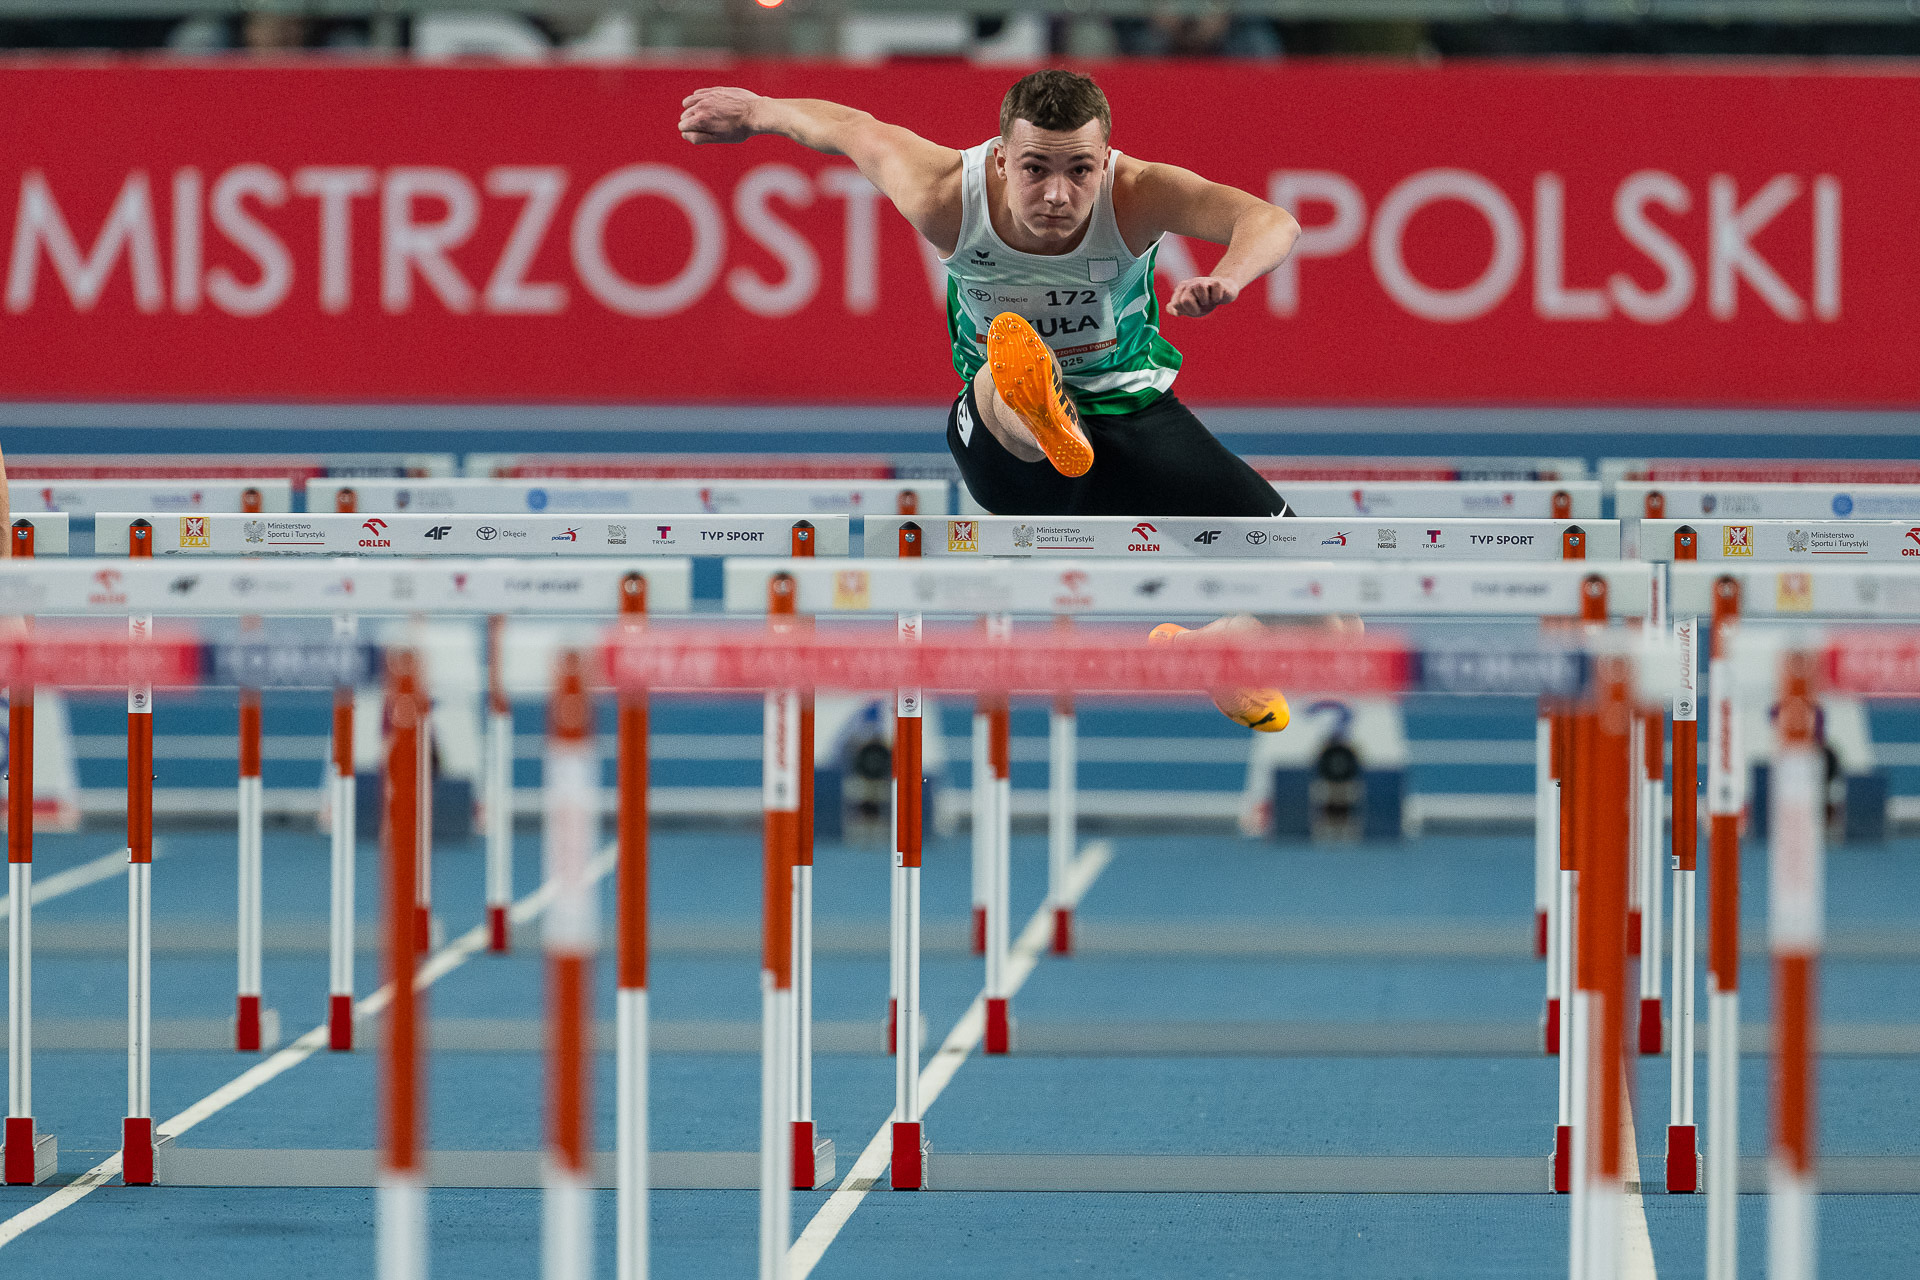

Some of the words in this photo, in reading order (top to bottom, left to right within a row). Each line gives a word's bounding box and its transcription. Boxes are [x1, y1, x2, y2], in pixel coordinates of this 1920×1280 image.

[4, 164, 1204, 318] MISTRZOST
[1265, 167, 1843, 323] POLSKI
[970, 258, 996, 267] erima
[998, 296, 1029, 304] Okęcie
[1045, 290, 1098, 306] 172
[1060, 356, 1084, 368] 025
[267, 522, 311, 530] Ministerstwo
[267, 530, 290, 539] Sportu
[296, 530, 326, 539] Turystyki
[424, 526, 452, 540] 4F
[502, 530, 527, 539] Okęcie
[700, 531, 724, 541] TVP
[727, 531, 764, 541] SPORT
[1194, 530, 1222, 545] 4F
[1811, 531, 1855, 539] Ministerstwo
[181, 537, 208, 546] PZLA
[1036, 535, 1059, 543] Sportu
[1065, 535, 1095, 543] Turystyki
[1272, 534, 1297, 543] Okęcie
[1470, 535, 1494, 545] TVP
[1496, 535, 1534, 545] SPORT
[358, 539, 391, 548] ORLEN
[950, 541, 977, 550] PZLA
[1127, 544, 1160, 552] ORLEN
[1811, 540, 1834, 548] Sportu
[1839, 540, 1869, 549] Turystyki
[1724, 546, 1751, 555] PZLA
[1901, 549, 1920, 557] ORL
